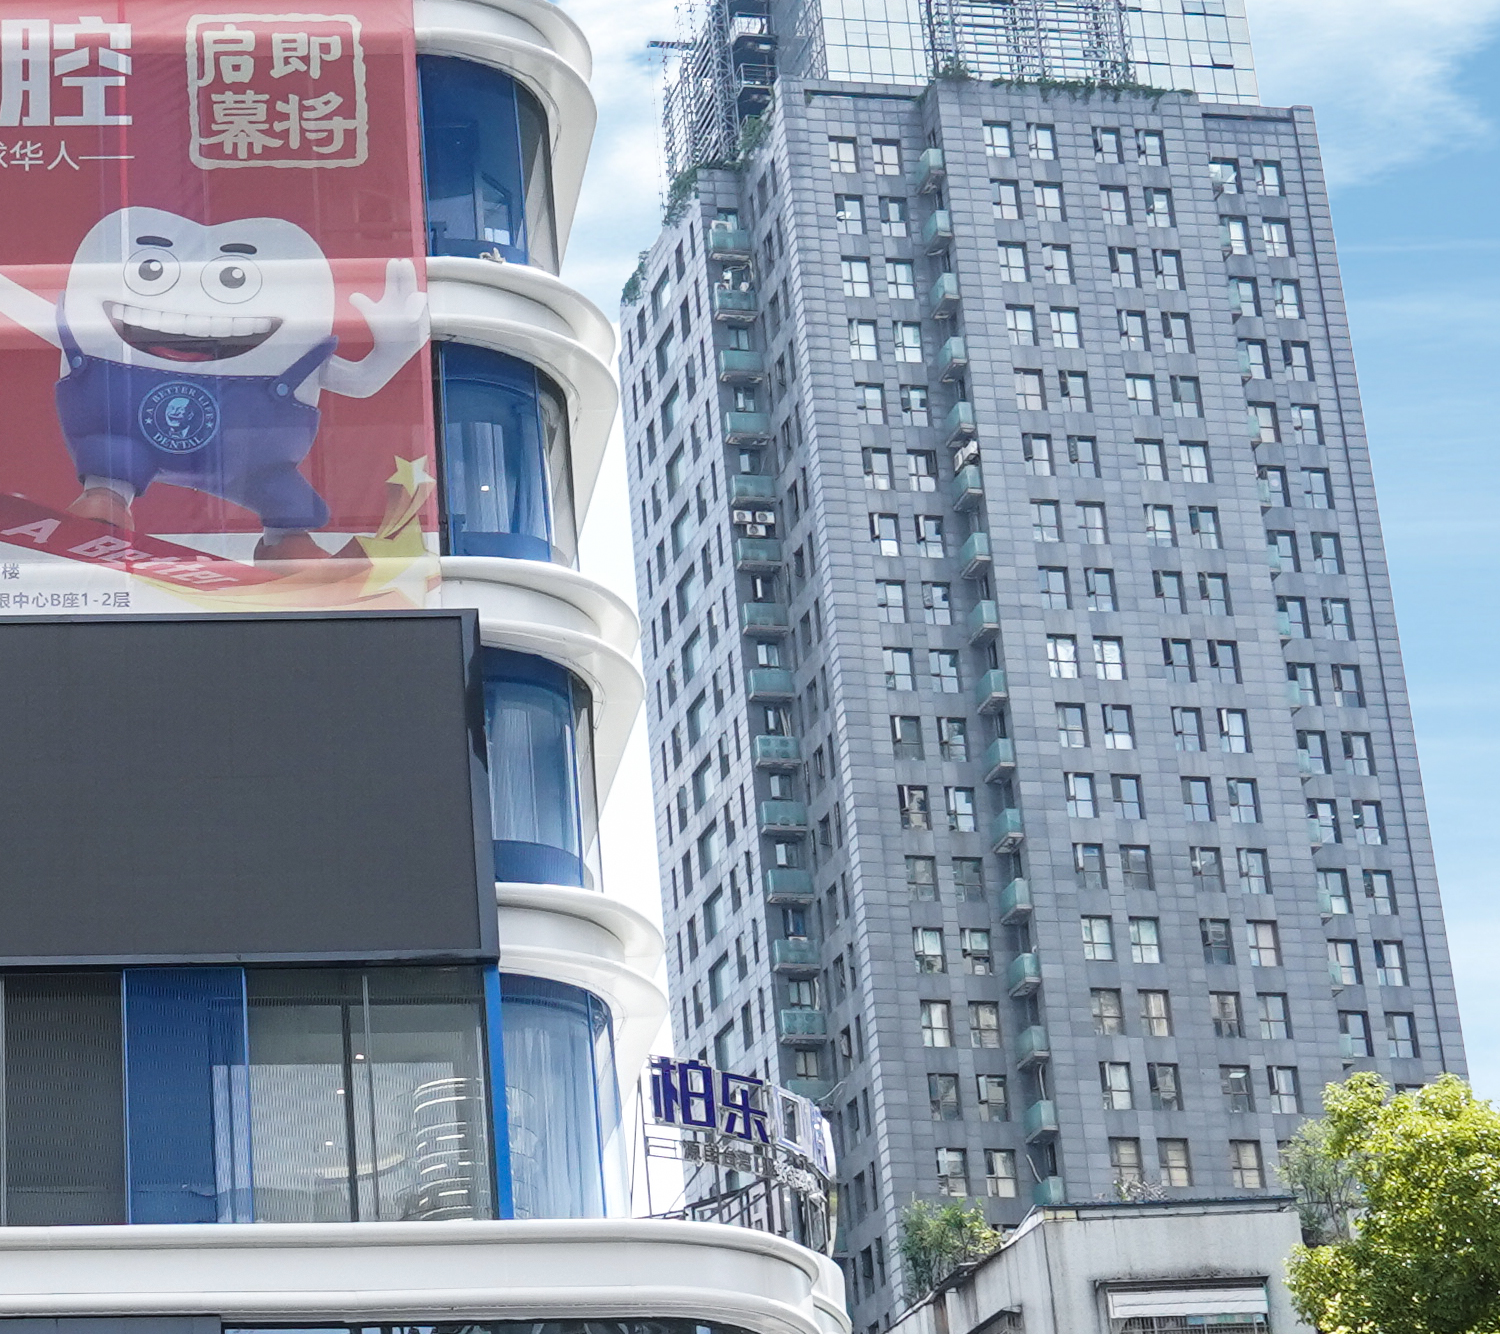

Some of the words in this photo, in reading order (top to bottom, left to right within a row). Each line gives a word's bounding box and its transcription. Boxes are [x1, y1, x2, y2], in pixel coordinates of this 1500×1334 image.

[152, 386, 196, 403] BETTER
[198, 395, 214, 420] LIFE
[152, 432, 204, 449] DENTAL
[1, 517, 62, 544] A
[67, 534, 246, 593] Better
